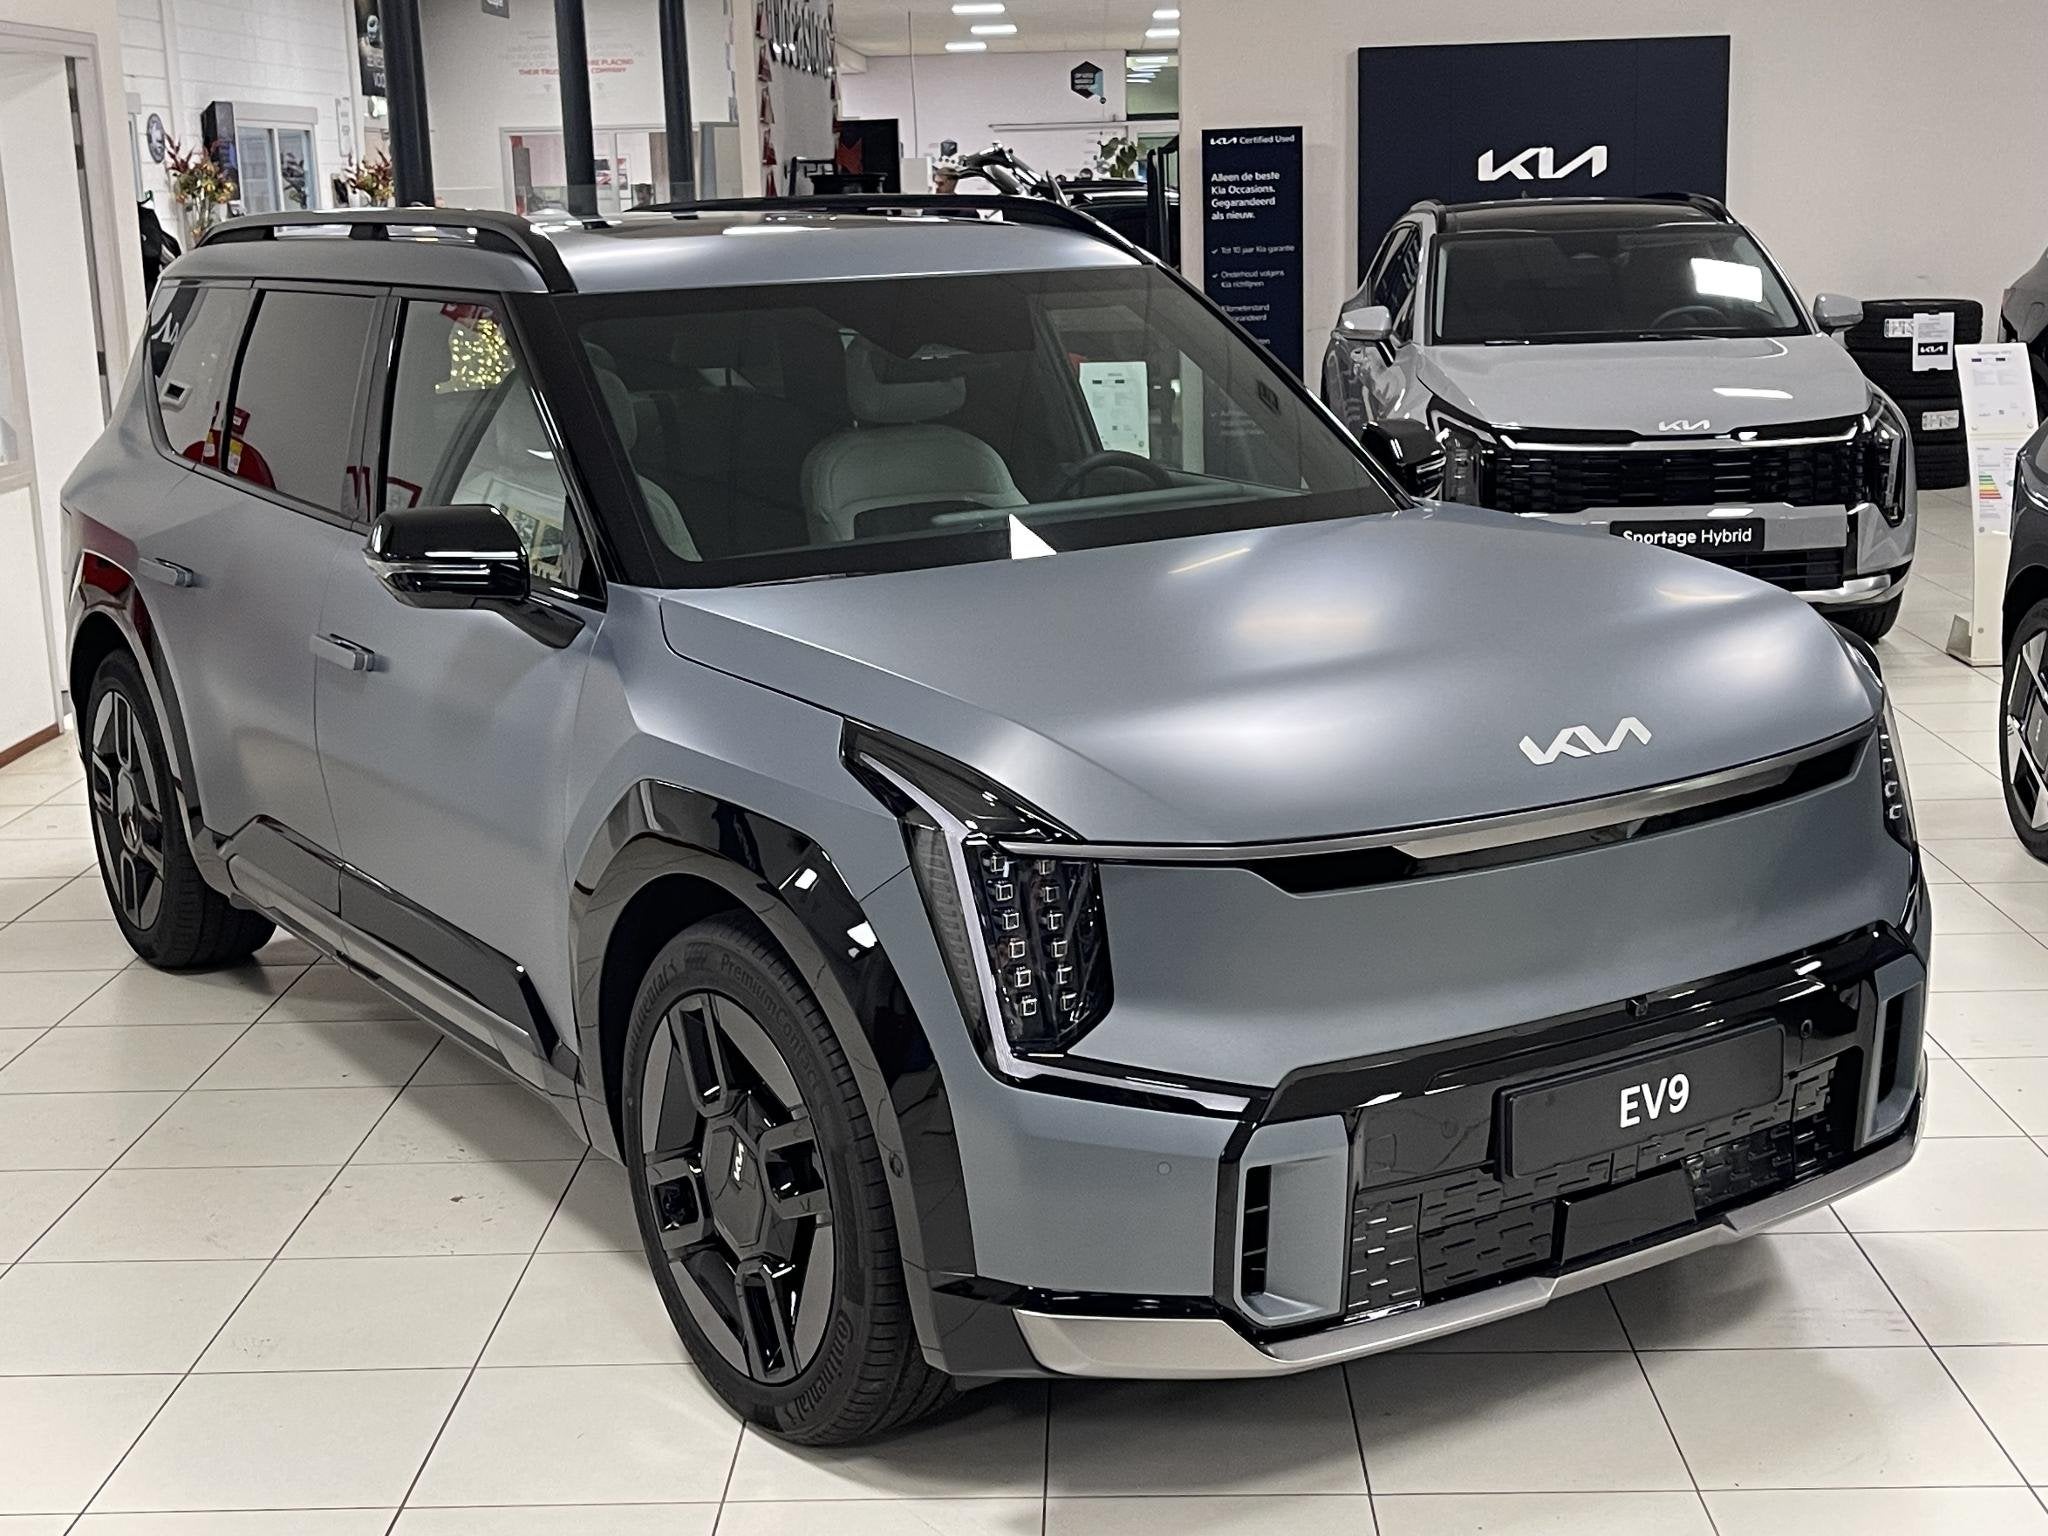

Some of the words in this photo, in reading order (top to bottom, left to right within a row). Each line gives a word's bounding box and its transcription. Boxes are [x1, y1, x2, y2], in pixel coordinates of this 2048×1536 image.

[1210, 137, 1237, 145] KIA
[1239, 135, 1273, 145] Certified
[1275, 134, 1295, 143] Used
[1478, 145, 1608, 181] KIA
[1211, 173, 1240, 182] Alleen
[1241, 172, 1254, 181] de
[1254, 171, 1280, 181] beste
[1211, 186, 1227, 195] Kia
[1228, 185, 1276, 195] Occasions.
[1211, 196, 1276, 210] Gegarandeerd
[1211, 211, 1225, 220] als
[1226, 210, 1256, 220] nieuw.
[1920, 345, 1944, 353] KIA
[1658, 419, 1711, 432] KIA
[1623, 530, 1697, 547] Sportage
[1701, 528, 1752, 546] Hybrid
[1518, 716, 1652, 766] KIA
[1620, 1073, 1690, 1129] EV9
[794, 1309, 854, 1422] Continental
